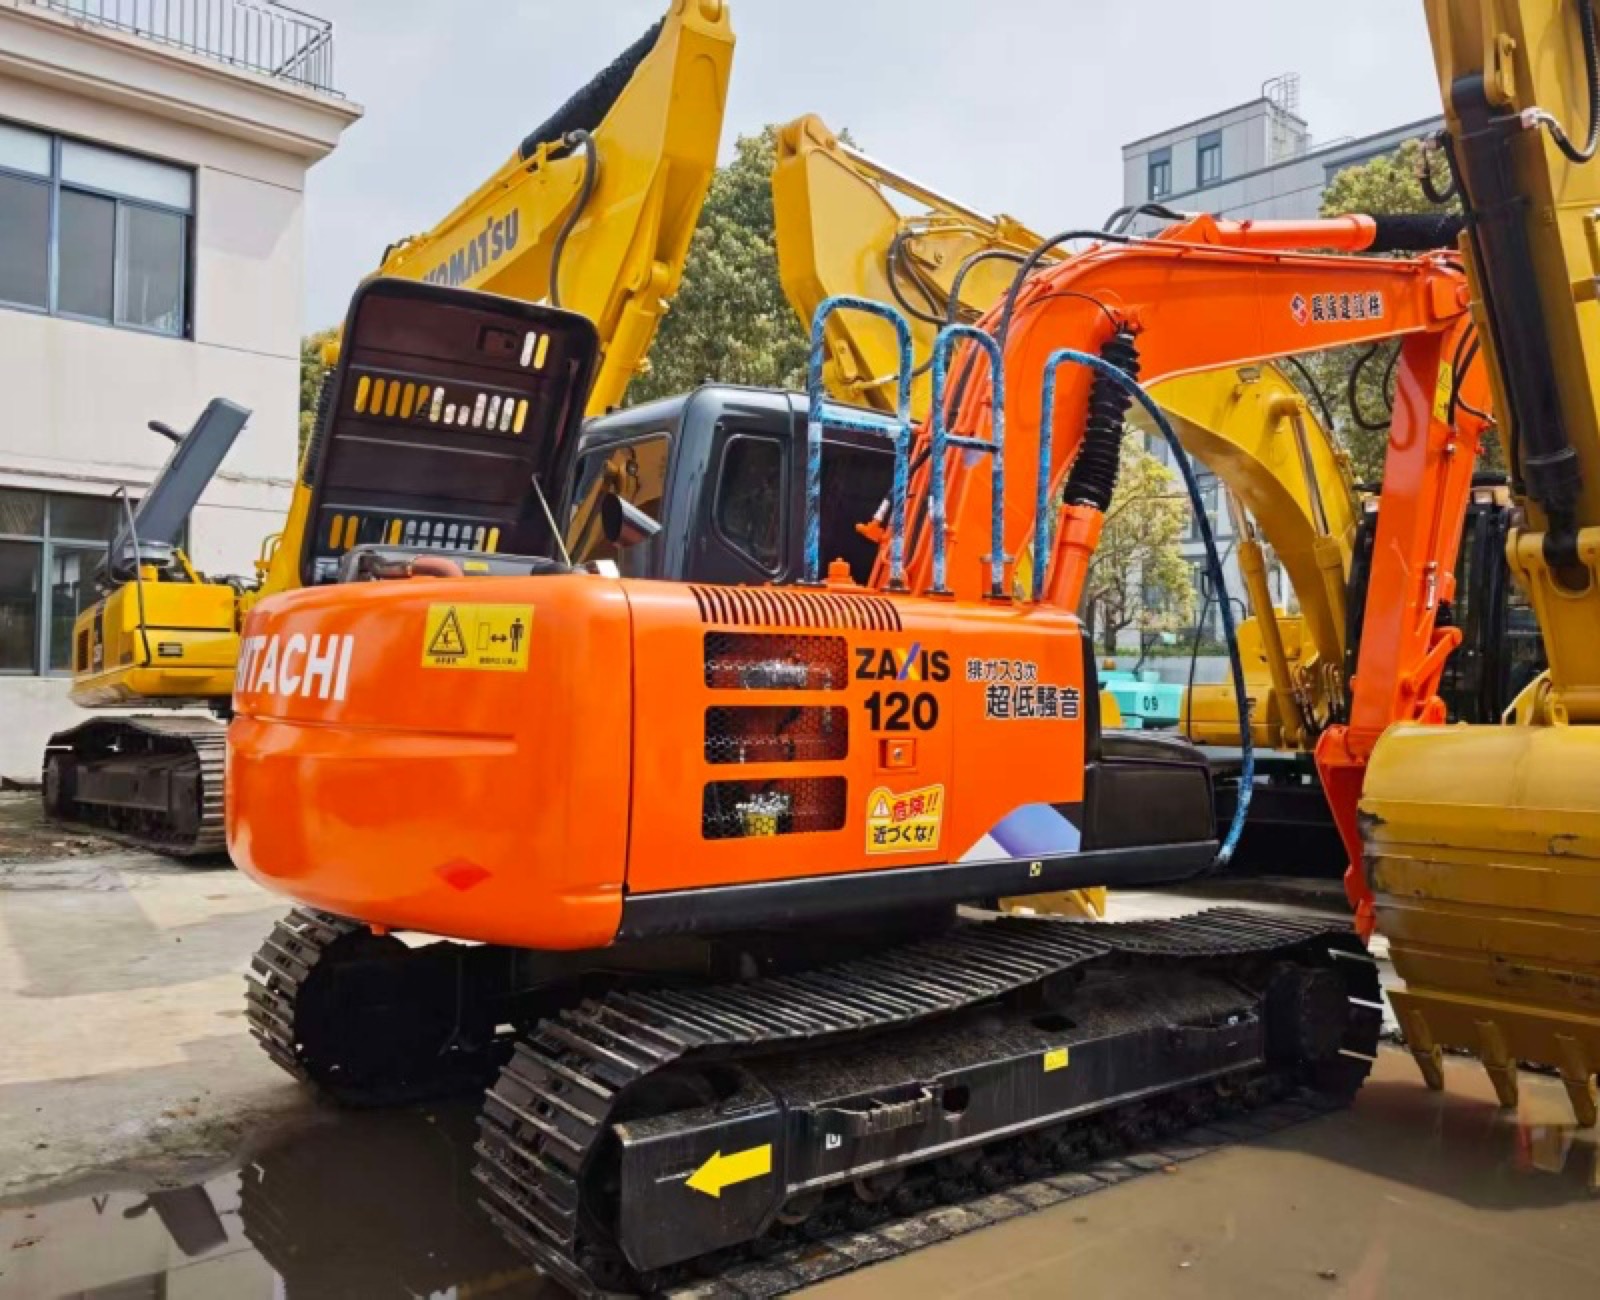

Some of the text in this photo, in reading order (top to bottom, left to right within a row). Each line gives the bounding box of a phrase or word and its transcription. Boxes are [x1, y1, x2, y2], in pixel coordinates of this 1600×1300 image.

[855, 642, 951, 683] ZAXIS
[864, 690, 939, 731] 120
[985, 683, 1080, 719] 超低騒音
[873, 823, 935, 845] 近づくな!
